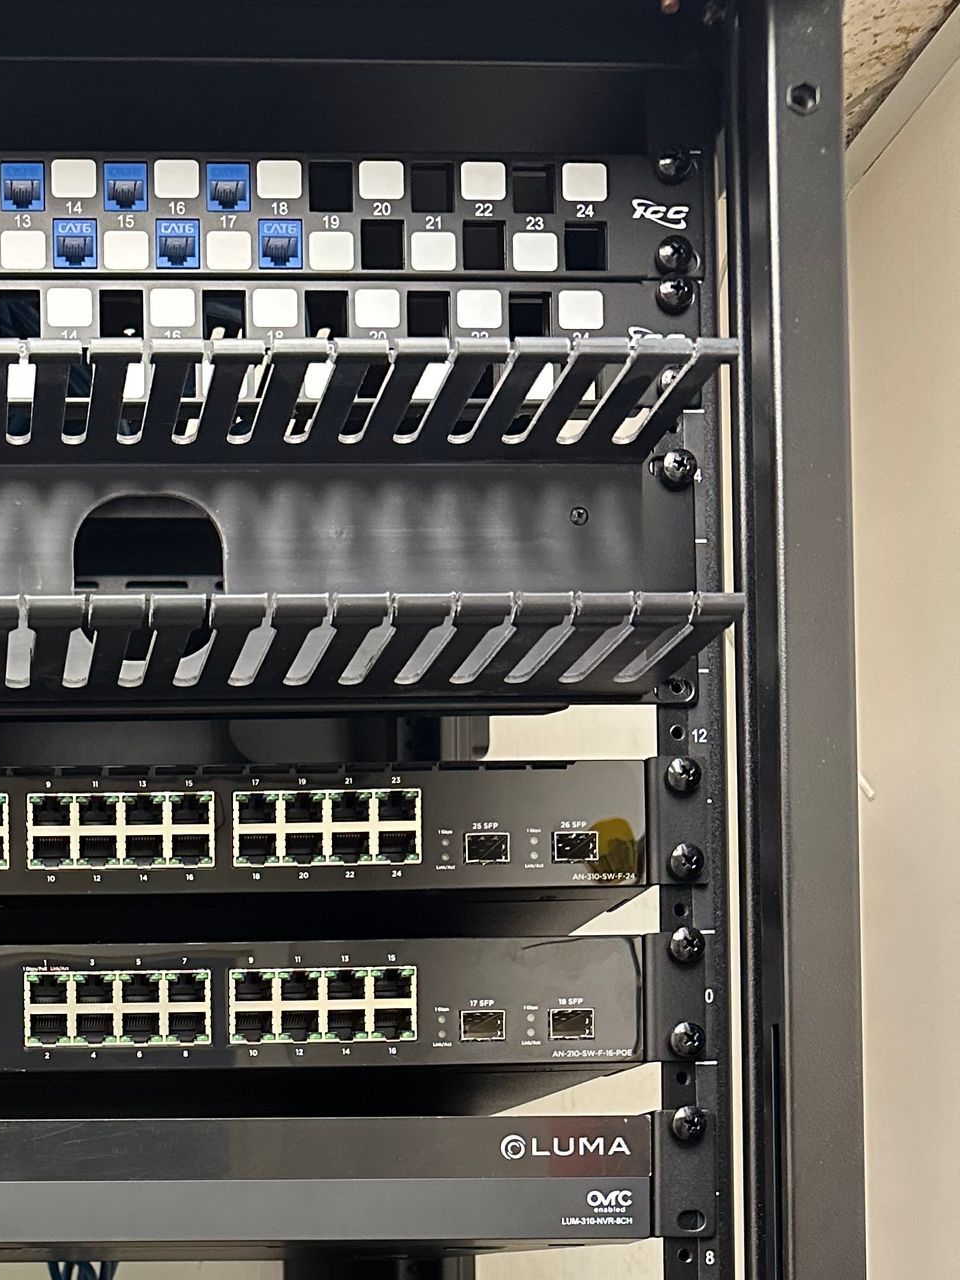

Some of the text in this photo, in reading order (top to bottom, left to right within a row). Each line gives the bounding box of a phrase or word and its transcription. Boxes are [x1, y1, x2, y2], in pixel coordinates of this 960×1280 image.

[66, 201, 82, 214] 14
[169, 202, 185, 215] 16
[272, 202, 288, 215] 18
[373, 202, 391, 215] 20
[475, 203, 493, 216] 22
[577, 204, 594, 217] 24
[15, 214, 31, 227] 13
[118, 215, 134, 228] 15
[220, 215, 236, 228] 17
[323, 216, 339, 228] 19
[426, 216, 441, 229] 21
[526, 217, 544, 230] 23
[692, 729, 707, 742] 12
[532, 1137, 630, 1156] LUMA
[706, 1251, 714, 1264] 8
